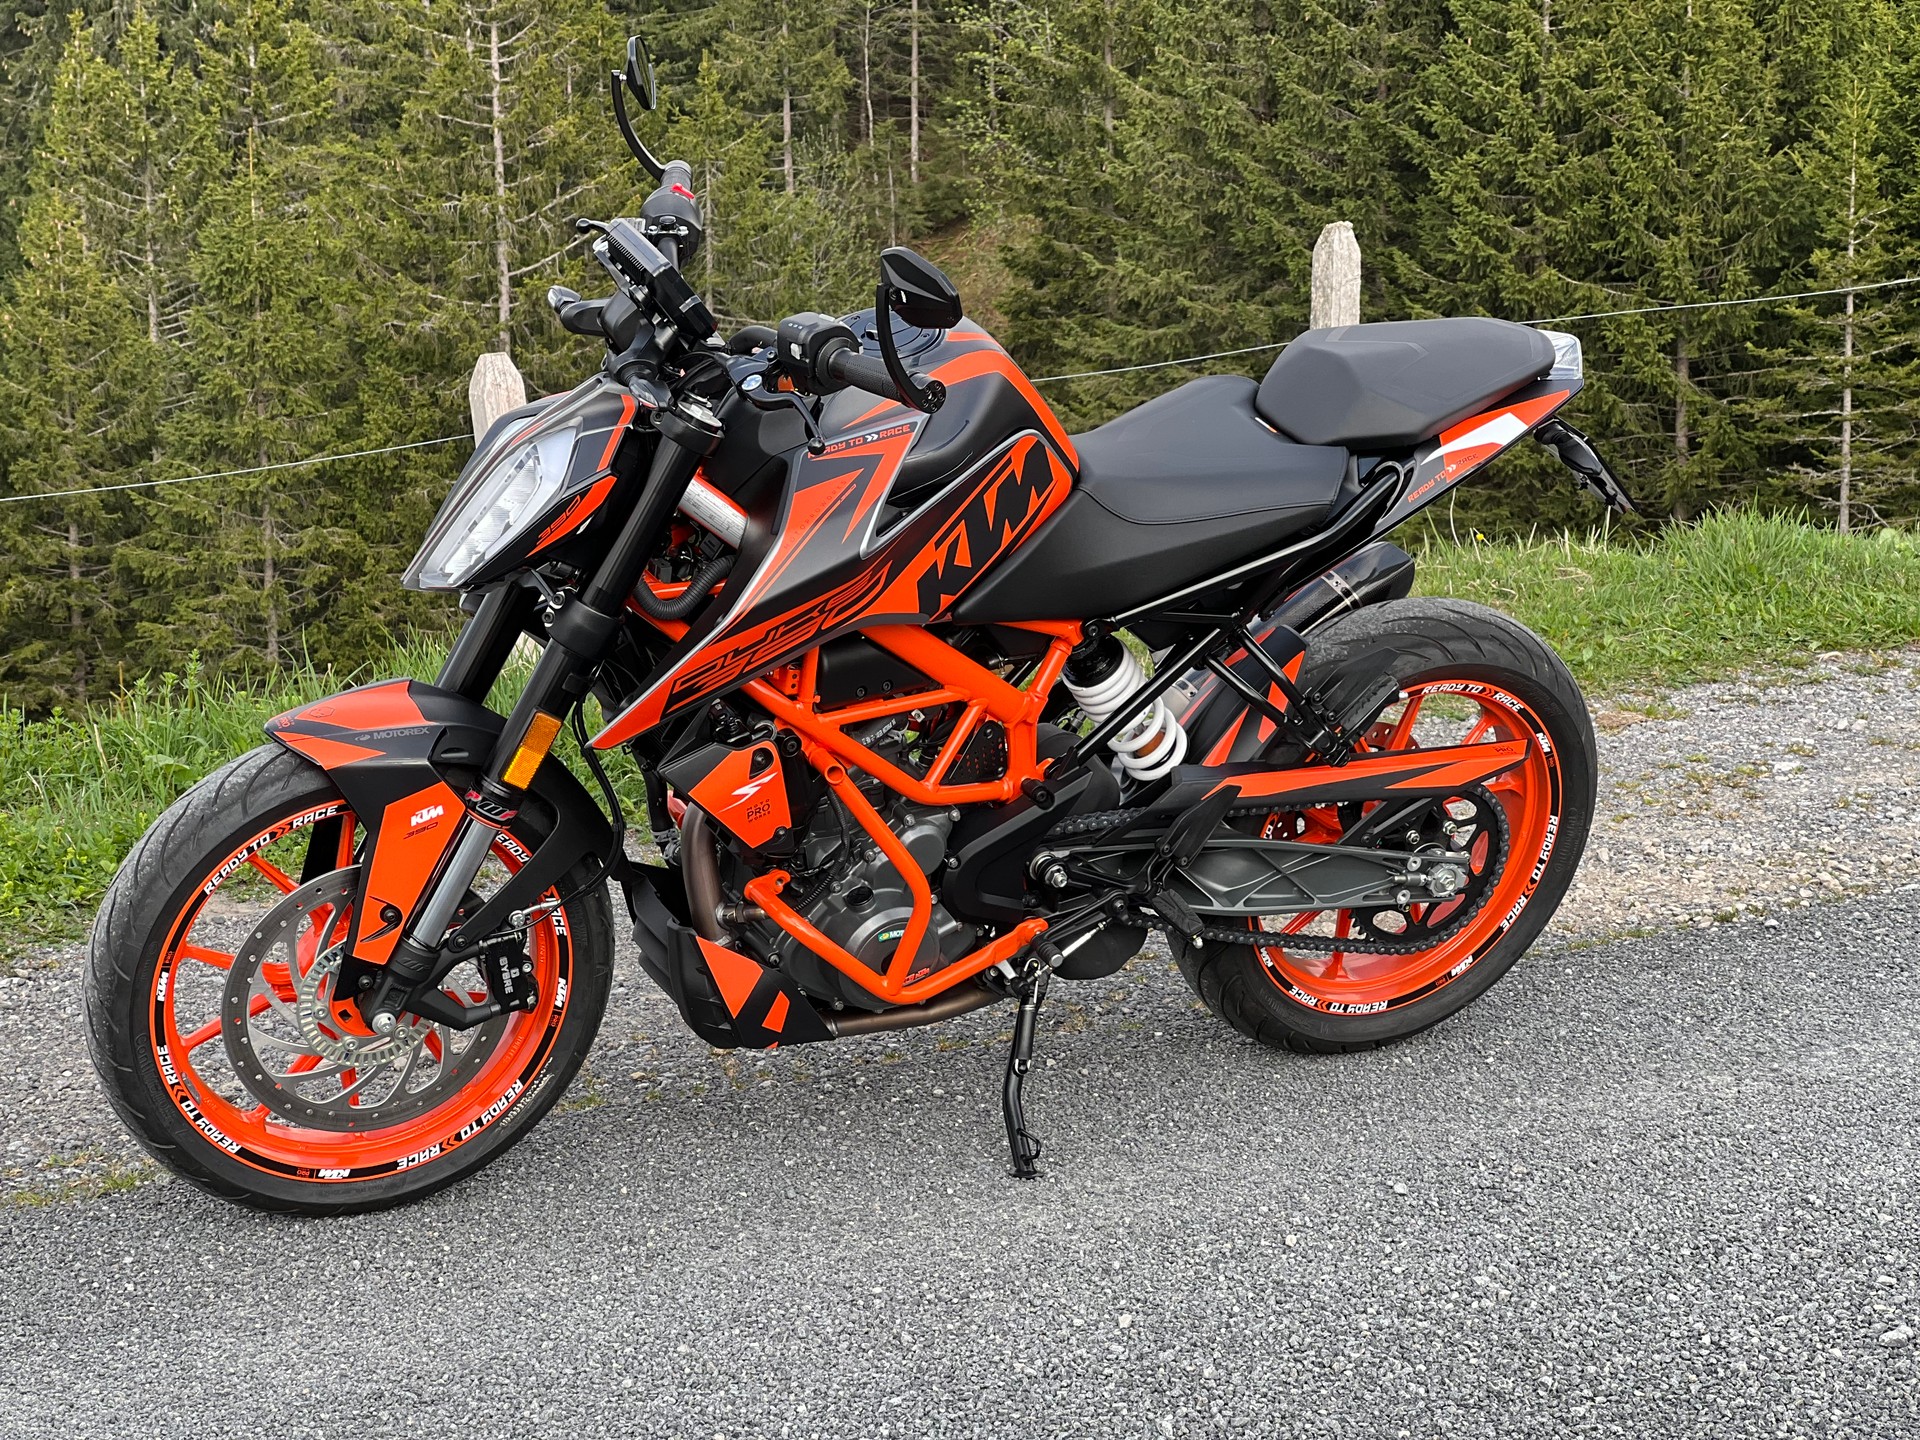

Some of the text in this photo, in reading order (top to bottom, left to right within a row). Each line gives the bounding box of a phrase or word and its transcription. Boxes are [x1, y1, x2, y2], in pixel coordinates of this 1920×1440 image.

[807, 424, 911, 459] ADY TO RACE
[1407, 479, 1435, 503] READY
[1434, 470, 1447, 482] TO
[916, 438, 1056, 620] KTM
[1421, 683, 1525, 713] READY TO RACE
[372, 727, 431, 741] MOTOREX
[1535, 732, 1552, 753] KTM
[410, 805, 444, 827] KTM
[747, 803, 771, 820] PRO
[403, 821, 439, 840] 390
[203, 805, 339, 896] READY TO RACE
[495, 830, 530, 863] EADY
[1500, 814, 1559, 932] READY TO RACE
[498, 955, 514, 995] BYBRE
[1451, 955, 1473, 977] KTM
[156, 971, 170, 1002] KTM
[554, 977, 568, 1008] KTM
[1288, 985, 1389, 1014] READY TO RACE
[156, 1044, 242, 1154] READY TO RACE
[396, 1078, 524, 1170] READY TO RACE
[317, 1168, 351, 1180] KTM
